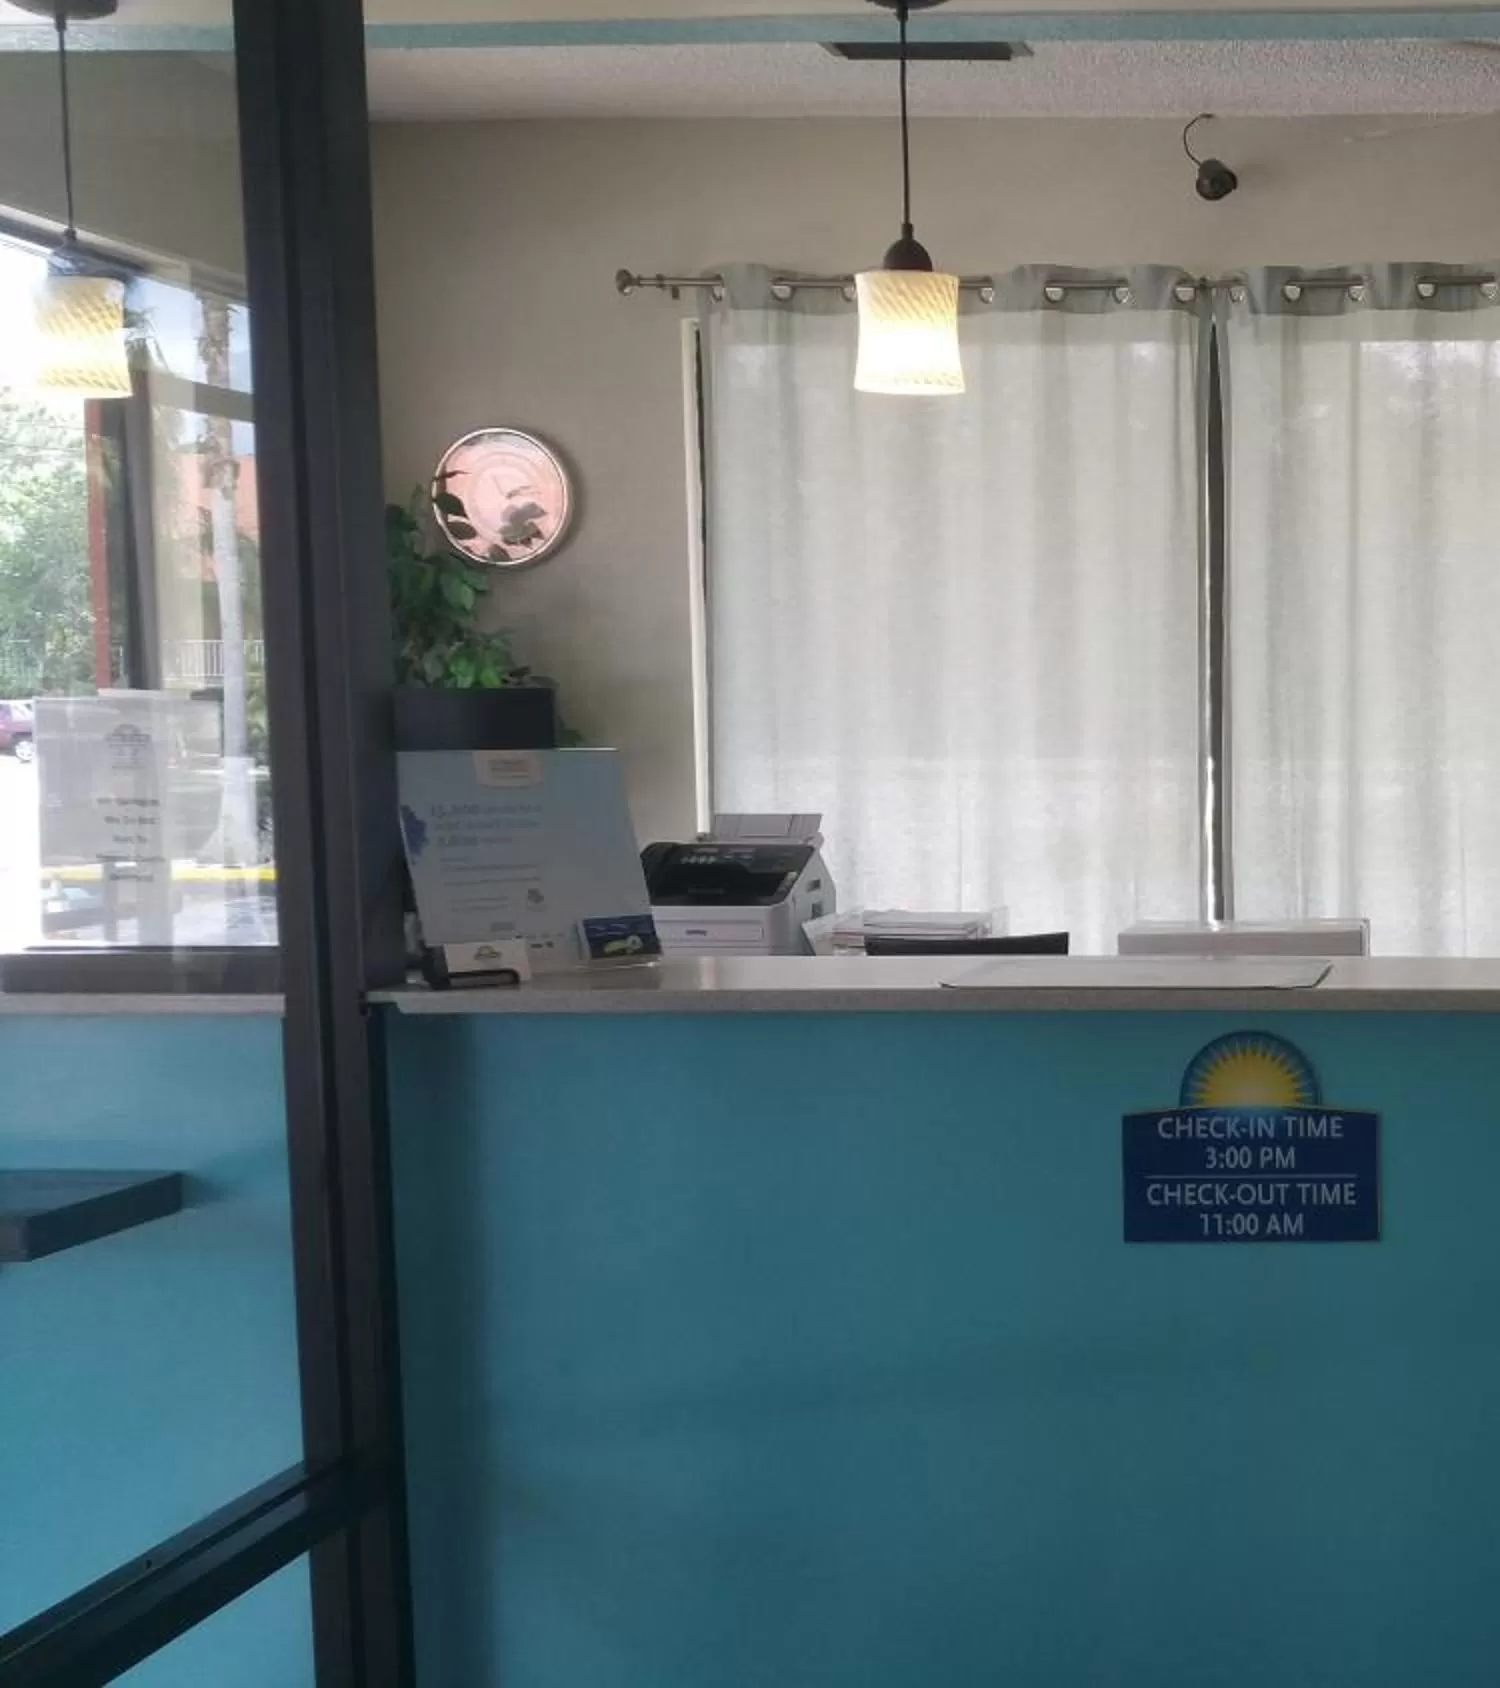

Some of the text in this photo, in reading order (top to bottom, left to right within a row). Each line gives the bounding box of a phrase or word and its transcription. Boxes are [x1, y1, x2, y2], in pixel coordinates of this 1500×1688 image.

[1157, 1116, 1344, 1139] CHECK-IN TIME
[1205, 1145, 1296, 1169] 3:00 PM
[1146, 1183, 1357, 1206] CHECK-OUT TIME
[1199, 1213, 1304, 1236] 11:00 AM
